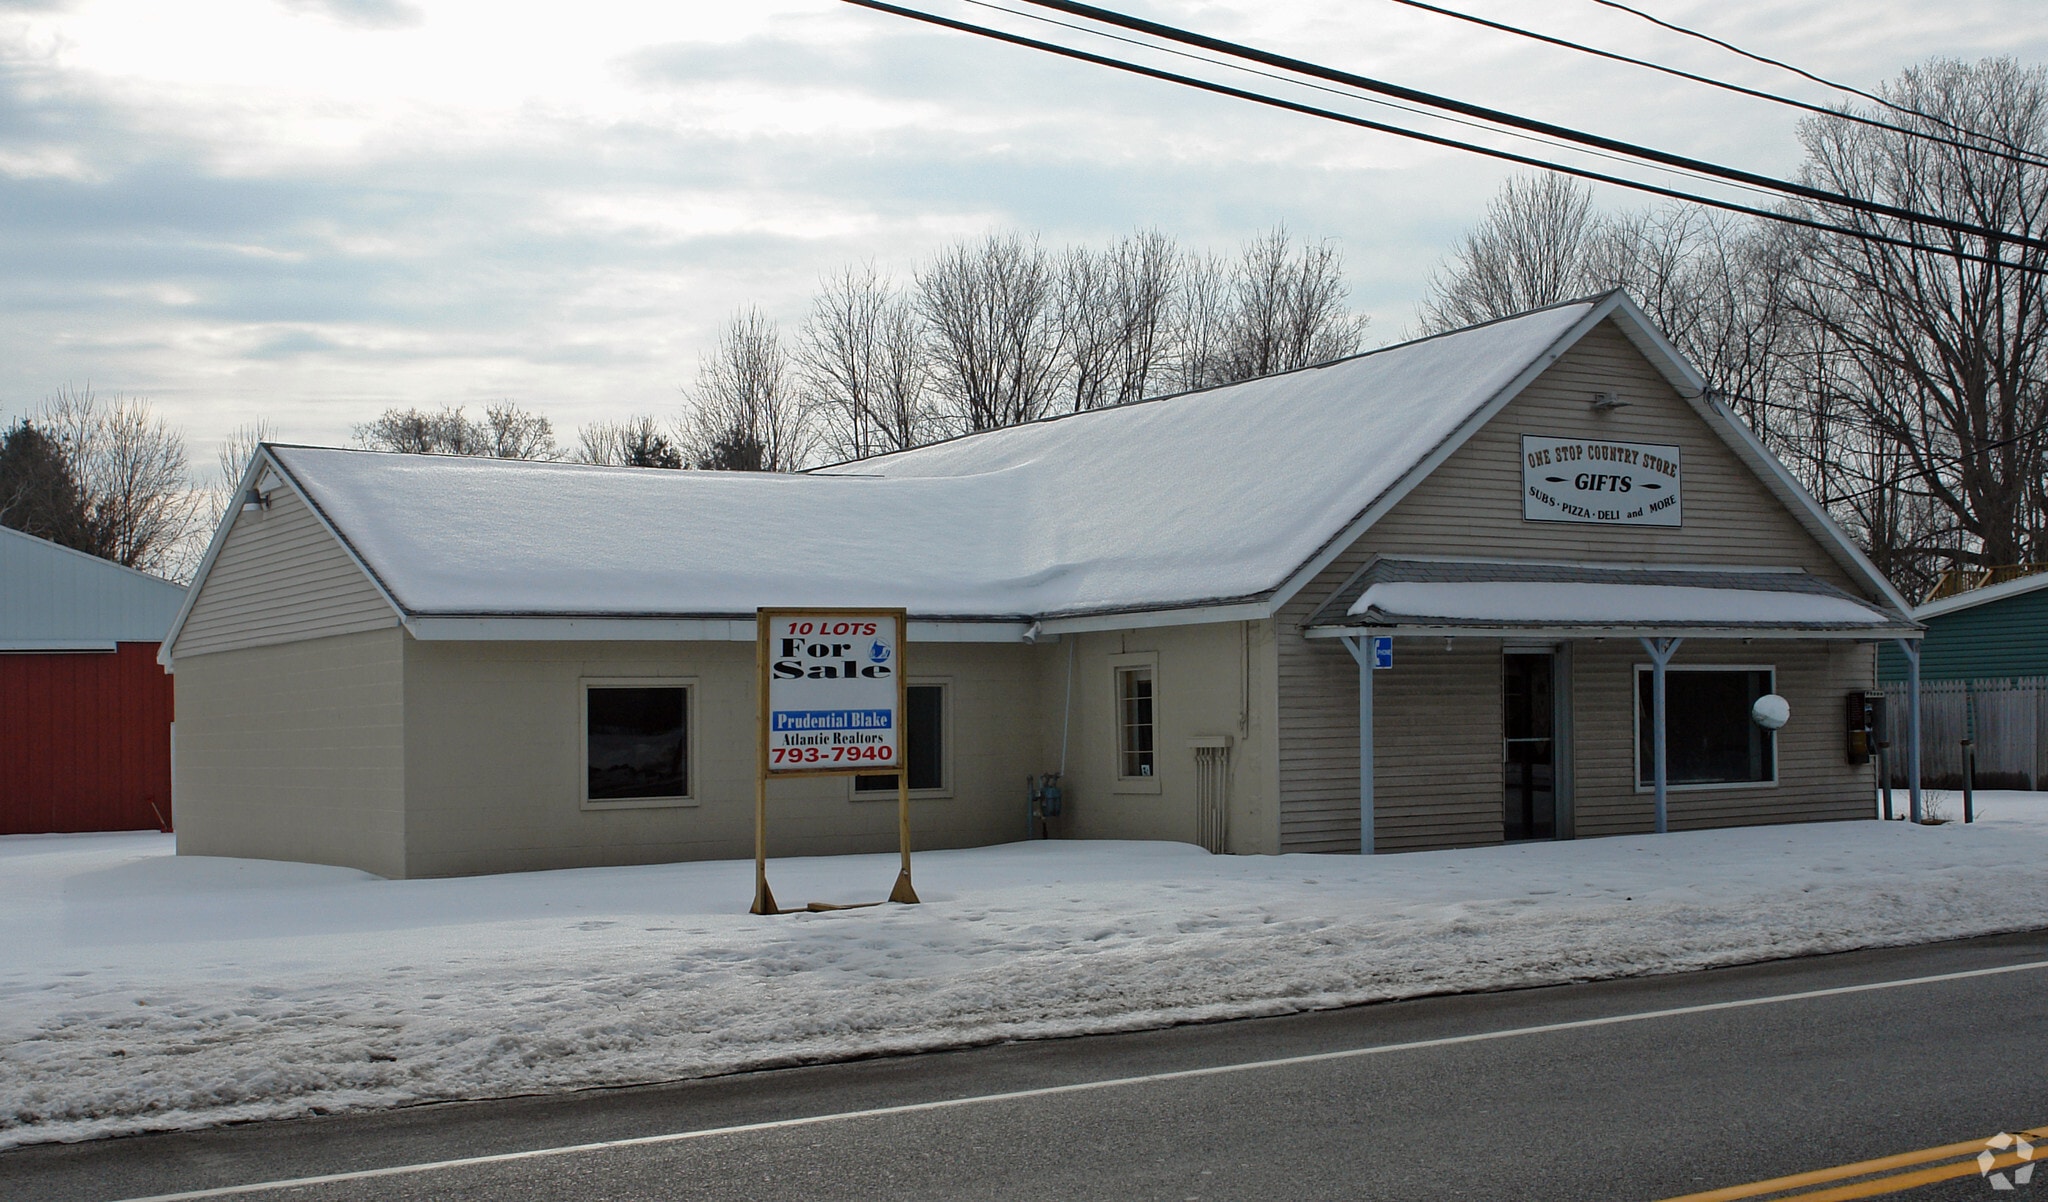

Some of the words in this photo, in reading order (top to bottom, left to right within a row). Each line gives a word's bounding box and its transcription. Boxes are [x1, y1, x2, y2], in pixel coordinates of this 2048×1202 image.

[1528, 449, 1551, 468] ONE
[1556, 445, 1583, 462] STOP
[1588, 445, 1639, 465] COUNTRY
[1642, 453, 1677, 478] STORE
[1575, 473, 1632, 492] GIFTS
[1597, 510, 1620, 520] DELI
[1626, 508, 1643, 519] and
[1649, 494, 1676, 514] MORE
[788, 623, 813, 635] 10
[819, 623, 877, 635] LOTS
[780, 638, 851, 657] For
[773, 661, 891, 679] Sale
[777, 712, 848, 729] Prudential
[851, 711, 888, 728] Blake
[782, 732, 830, 746] Atlantic
[833, 731, 884, 745] Realtors
[772, 746, 892, 763] 793-7940
